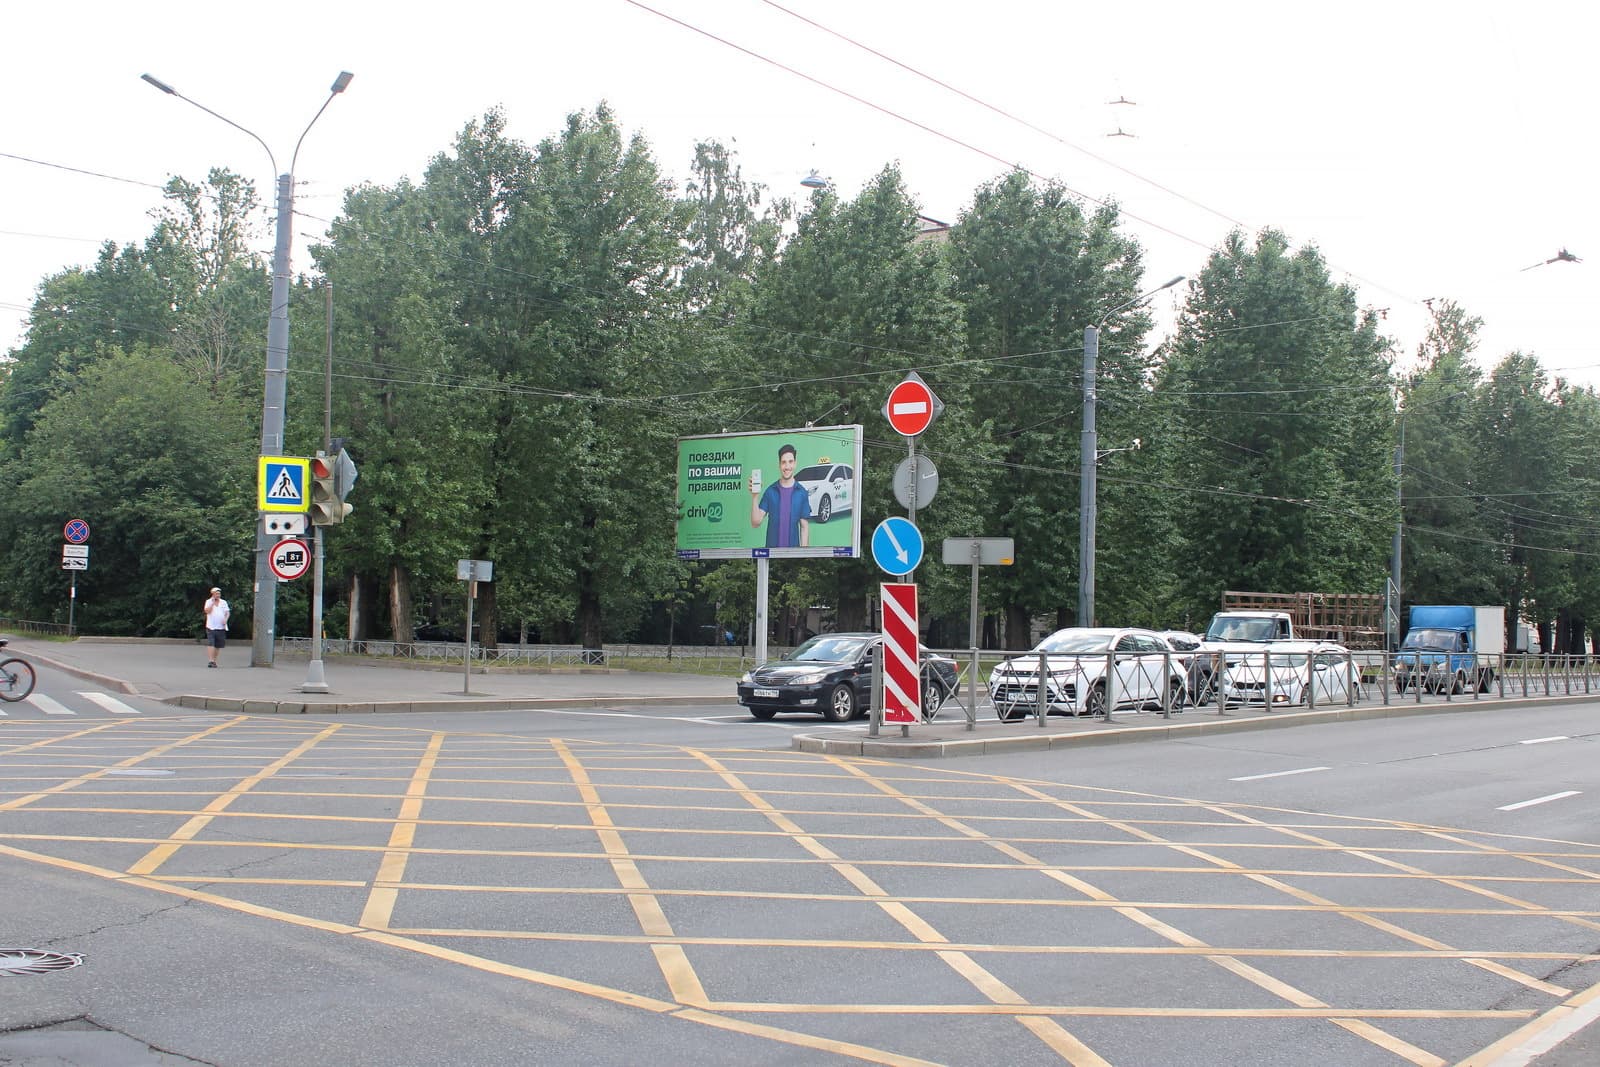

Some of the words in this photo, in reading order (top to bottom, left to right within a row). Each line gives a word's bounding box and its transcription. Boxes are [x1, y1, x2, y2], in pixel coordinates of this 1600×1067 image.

[688, 451, 735, 463] поездки
[688, 468, 702, 477] по
[704, 466, 741, 477] вашим
[687, 481, 741, 494] правилам
